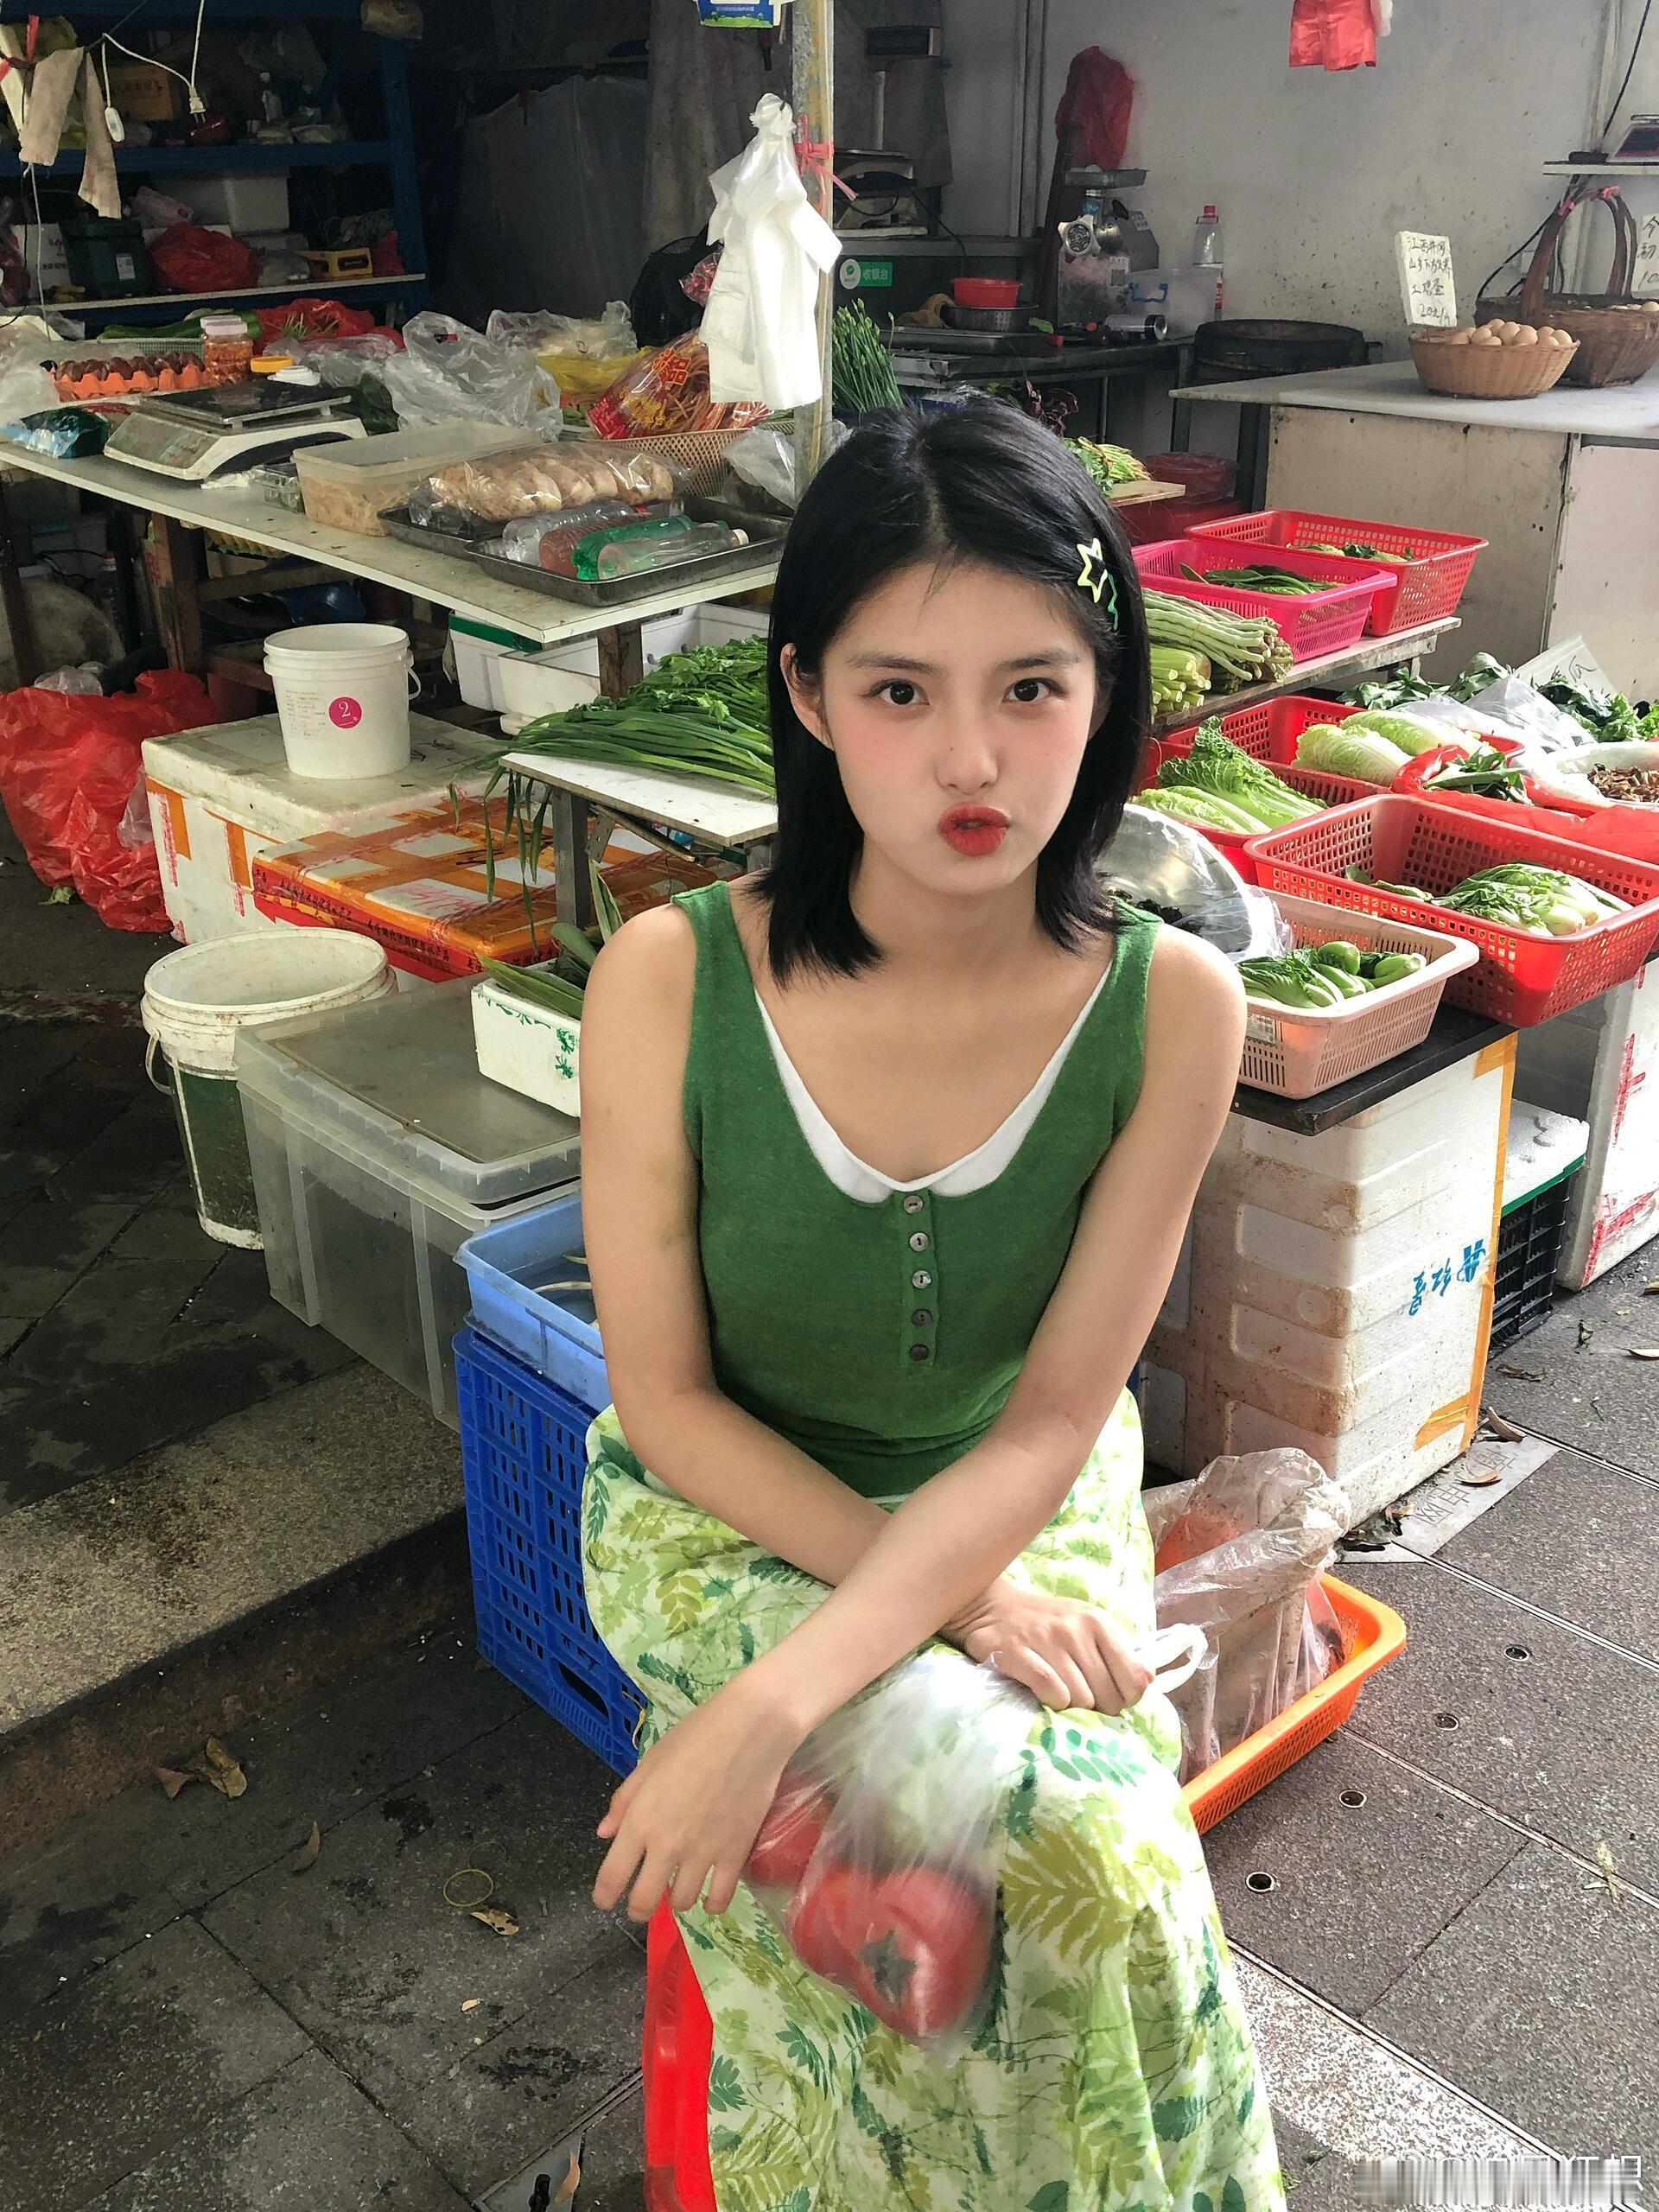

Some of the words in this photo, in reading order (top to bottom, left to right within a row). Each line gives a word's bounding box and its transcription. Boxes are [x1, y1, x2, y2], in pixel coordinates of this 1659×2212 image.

[862, 268, 888, 281] 收银台
[1411, 277, 1446, 296] 土鸡蛋
[338, 701, 352, 718] 2
